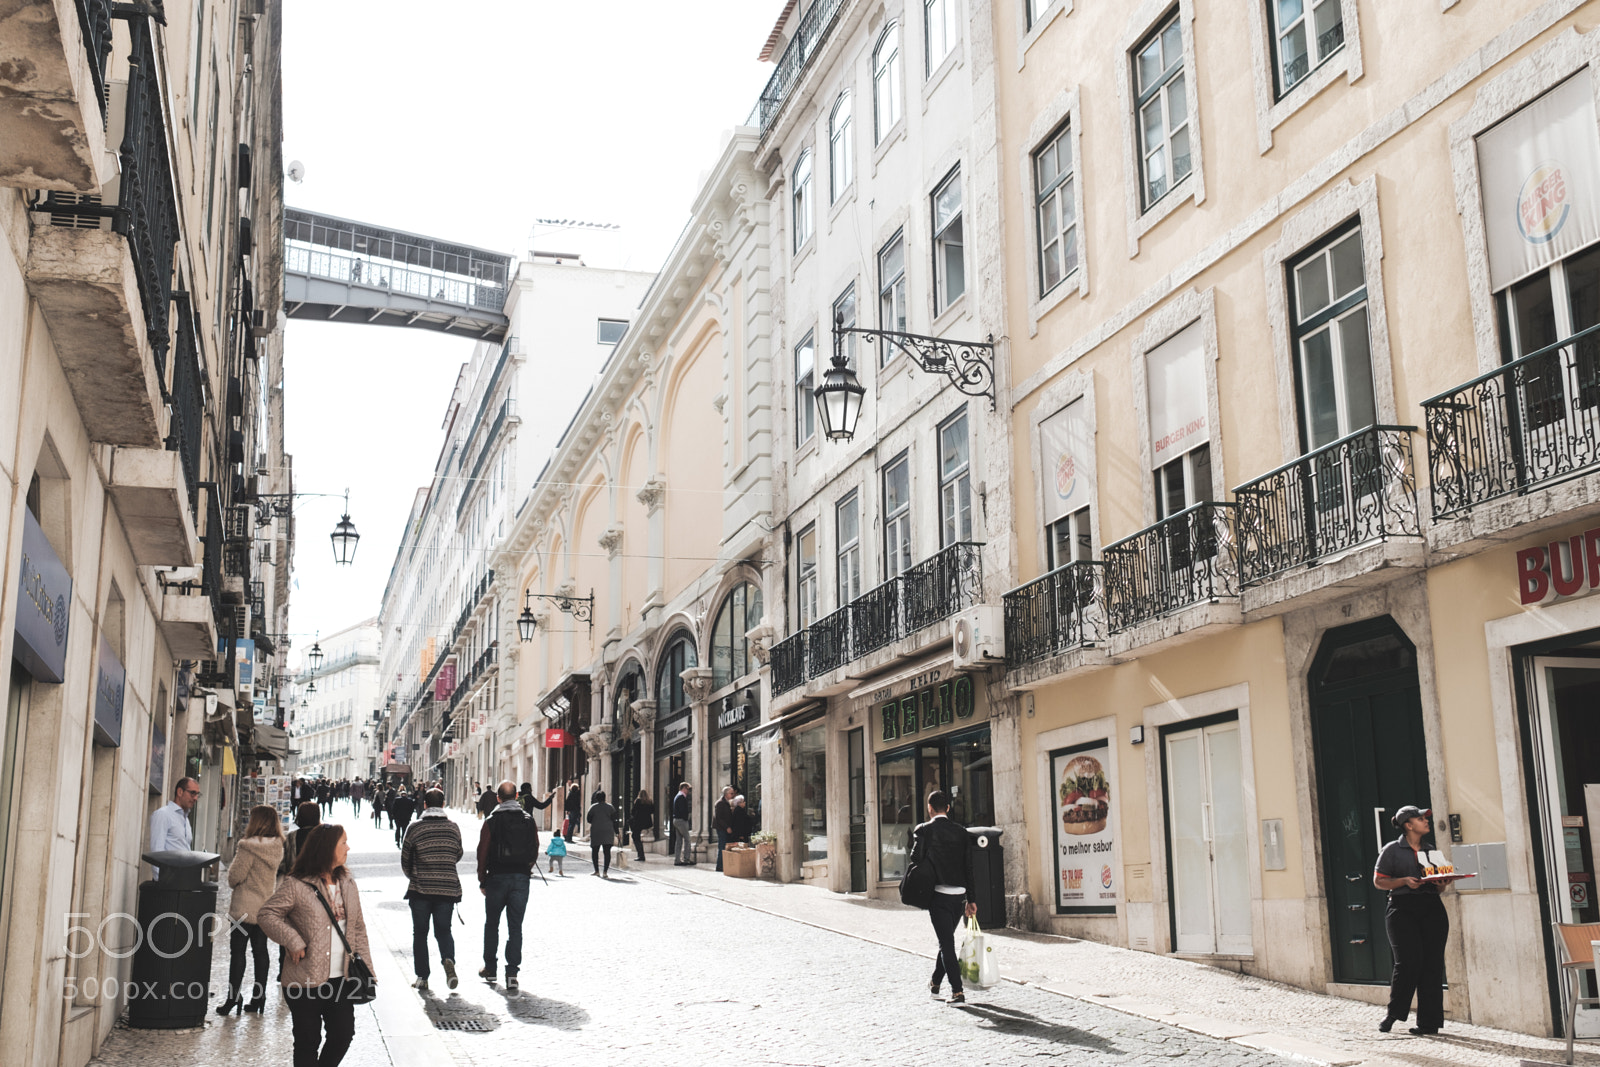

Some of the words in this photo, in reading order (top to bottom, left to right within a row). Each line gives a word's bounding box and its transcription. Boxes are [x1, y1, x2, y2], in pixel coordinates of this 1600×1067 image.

[1521, 168, 1562, 218] BURGER
[1525, 181, 1566, 235] KING
[1155, 427, 1184, 453] BURGER
[1186, 416, 1206, 436] KING
[1058, 463, 1075, 493] KING
[1068, 841, 1091, 855] melhor
